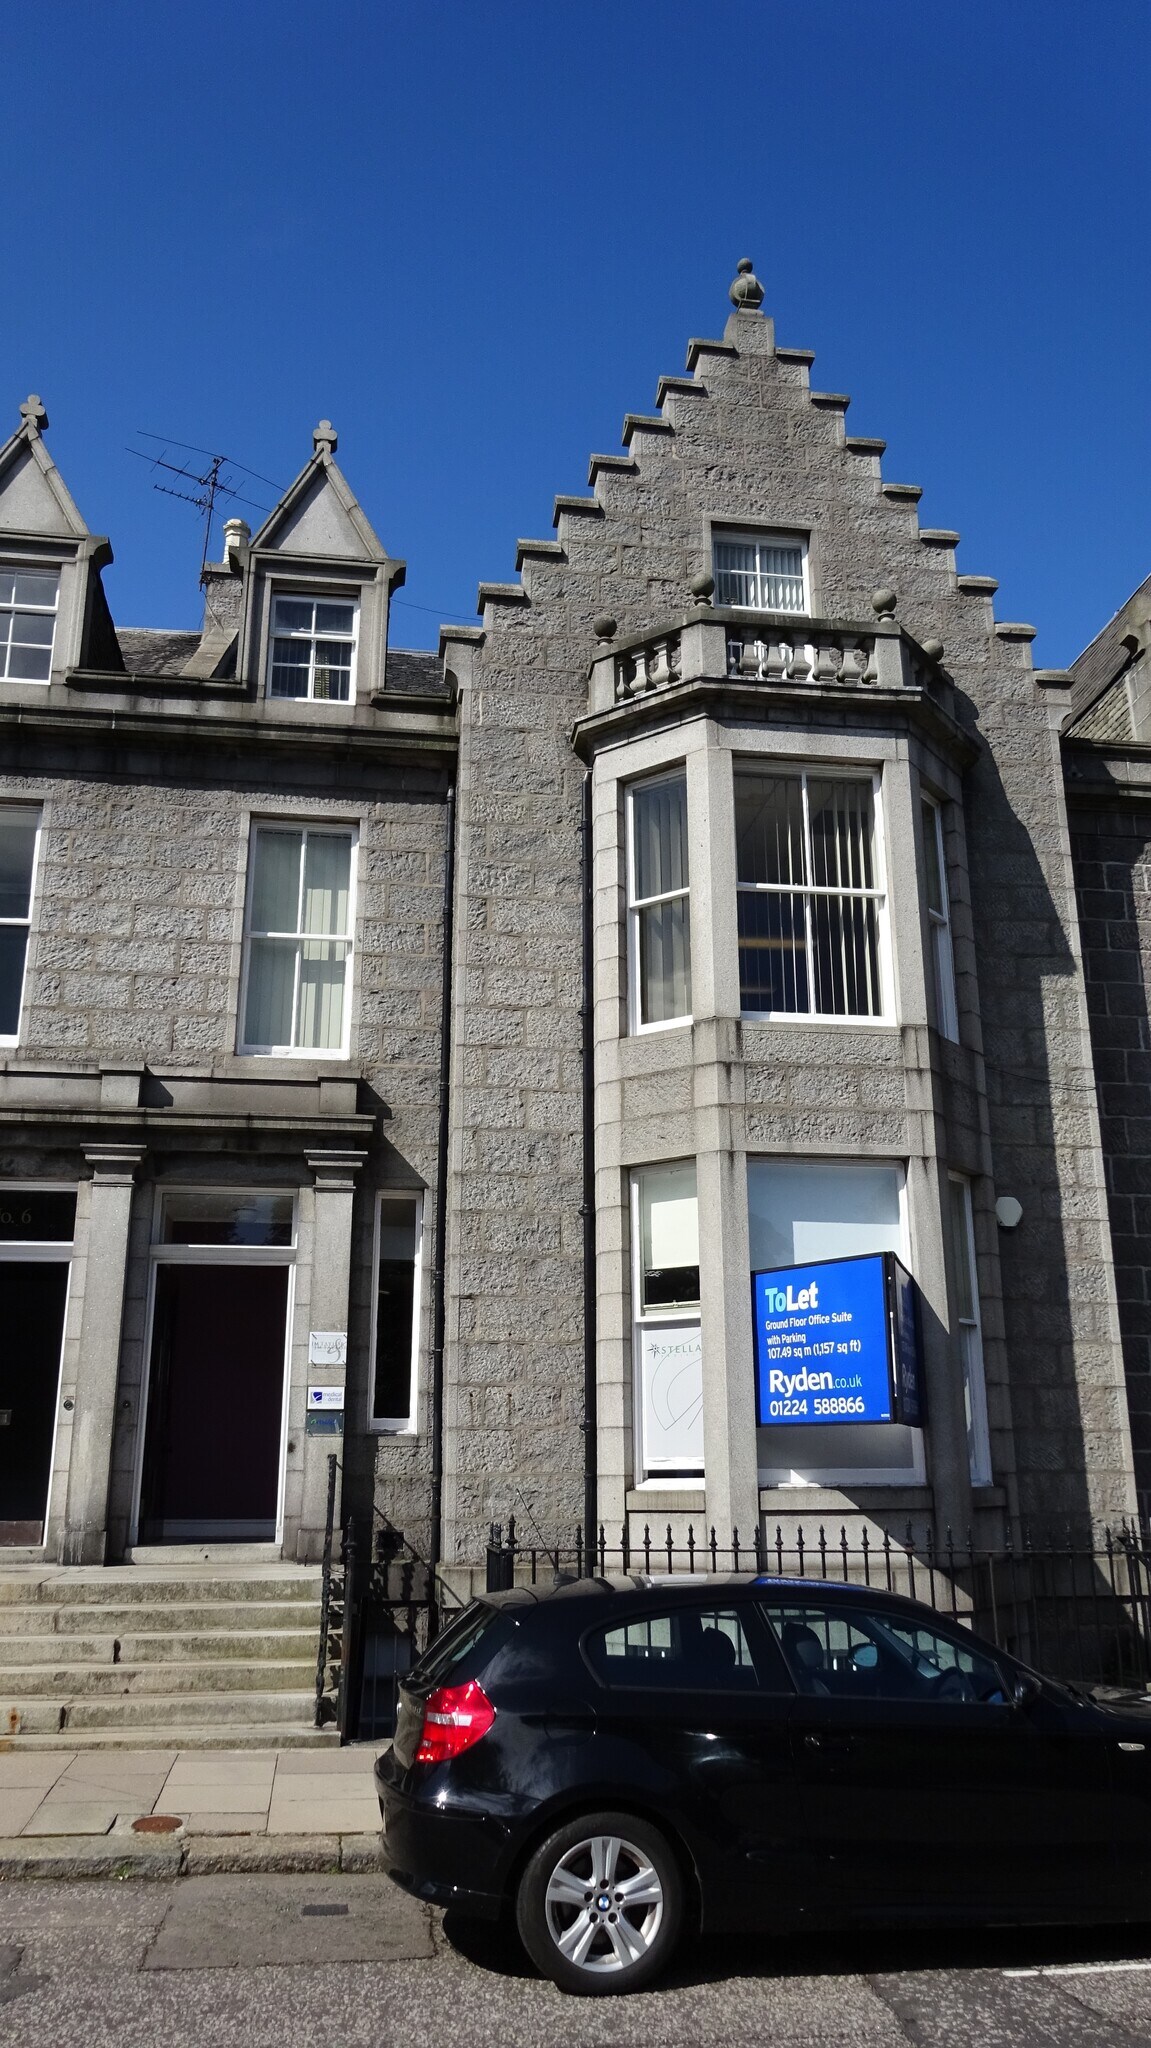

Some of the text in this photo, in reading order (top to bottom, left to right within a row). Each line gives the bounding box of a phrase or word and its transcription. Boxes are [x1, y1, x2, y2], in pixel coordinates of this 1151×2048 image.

[0, 1208, 32, 1224] o. 6
[765, 1311, 852, 1331] Ground Floor Office Suite
[767, 1332, 807, 1345] with Parking
[661, 1344, 702, 1354] STELLA
[767, 1339, 862, 1359] 107.49 sq m (1,157 sq ft)
[769, 1366, 863, 1398] Ryden.co.uk
[770, 1396, 865, 1416] 01224 588866
